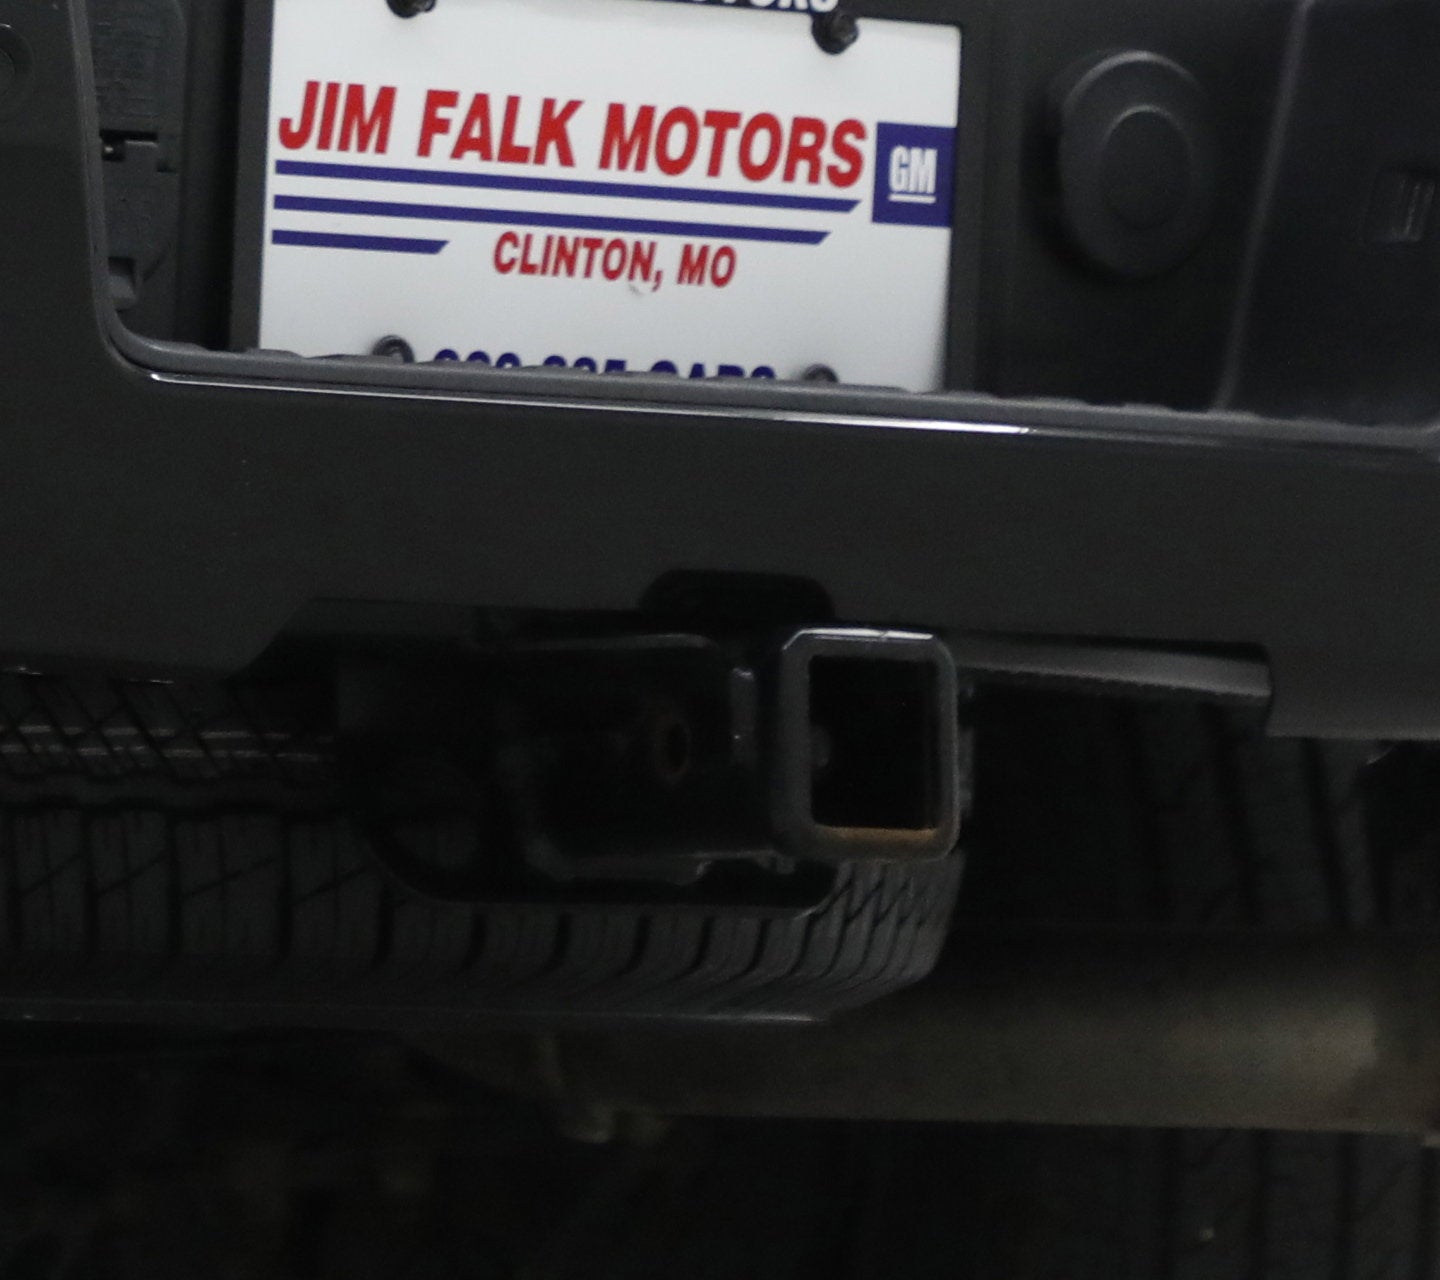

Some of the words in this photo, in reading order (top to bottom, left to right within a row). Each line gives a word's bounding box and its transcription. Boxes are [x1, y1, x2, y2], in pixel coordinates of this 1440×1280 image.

[278, 80, 397, 155] JIM
[417, 90, 584, 168] FALK
[599, 103, 868, 189] MOTORS
[888, 144, 937, 196] GM
[493, 230, 664, 293] CLINTON,
[678, 244, 737, 288] MO
